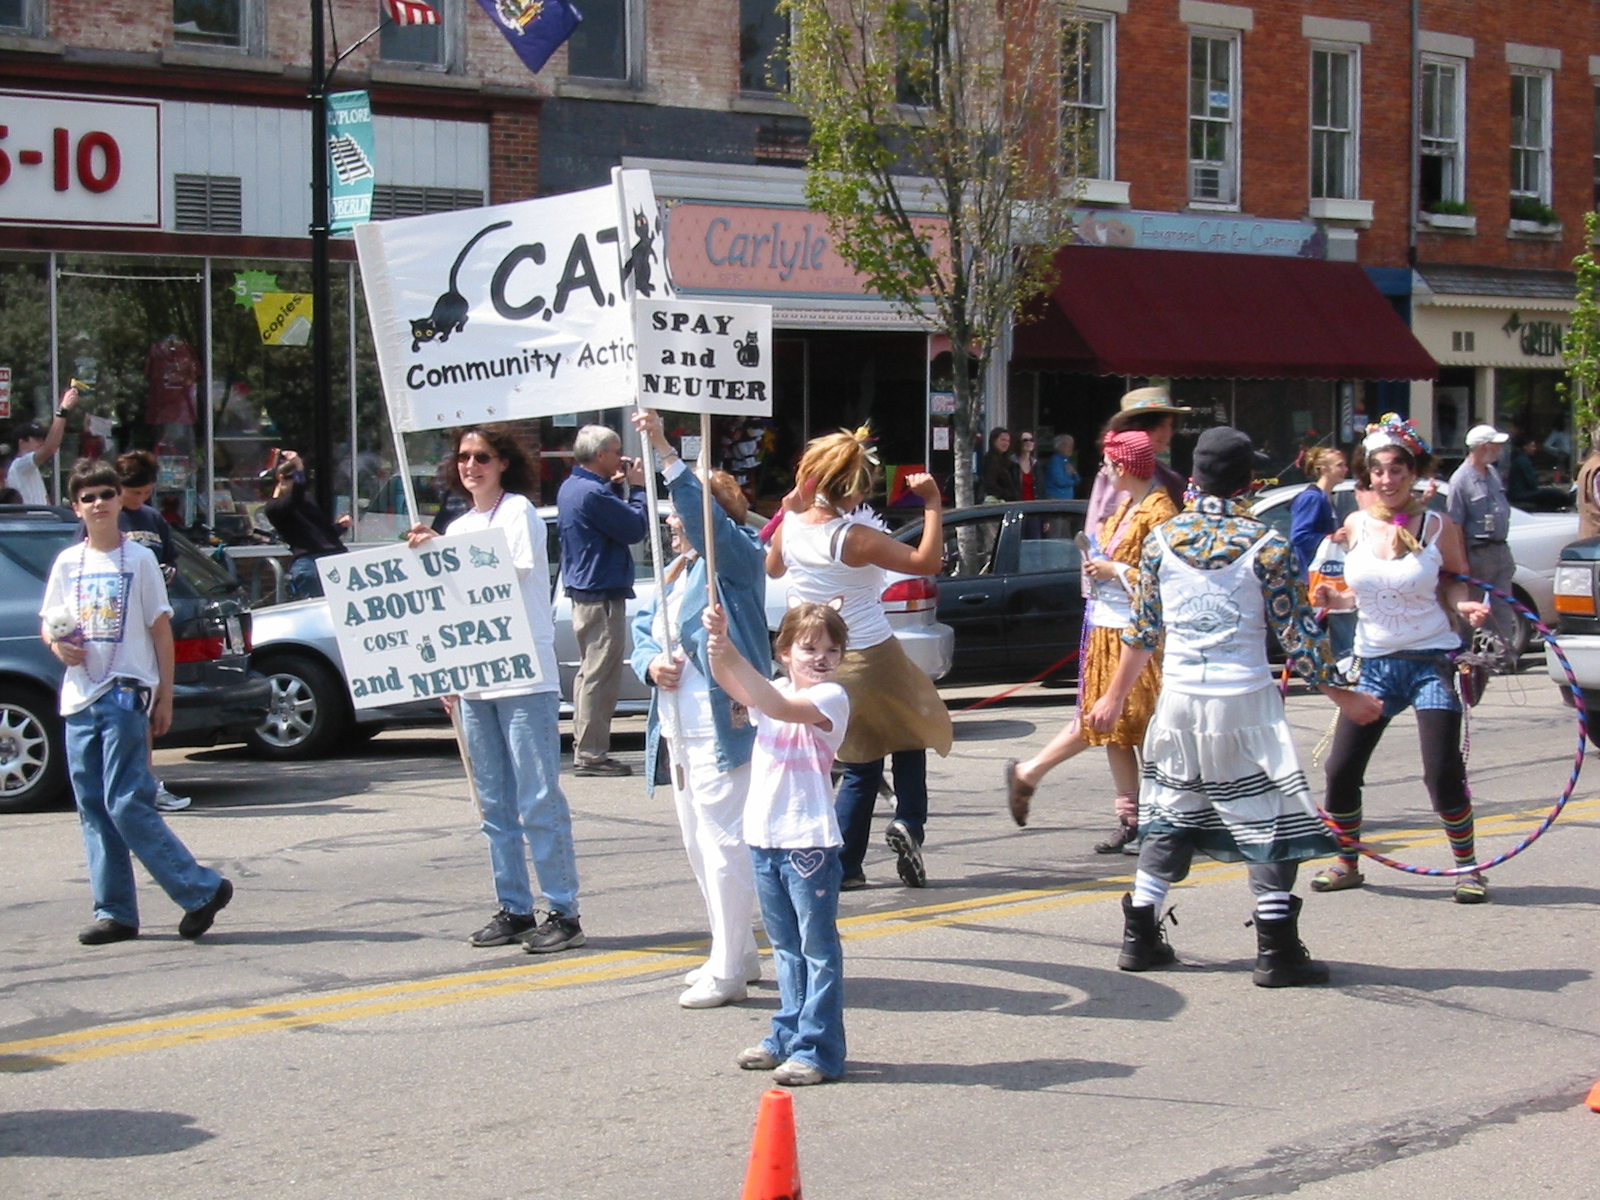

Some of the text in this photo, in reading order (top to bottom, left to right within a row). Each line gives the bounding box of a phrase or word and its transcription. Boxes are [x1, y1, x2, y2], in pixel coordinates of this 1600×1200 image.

[328, 107, 371, 125] EXPLORE
[331, 200, 370, 215] OBERLIN
[705, 217, 828, 281] Carlyle
[262, 294, 304, 340] copies
[652, 311, 734, 335] SPAY
[407, 349, 562, 390] Community
[661, 348, 716, 368] and
[642, 374, 767, 401] NEUTER
[346, 547, 461, 592] ASK US
[344, 583, 512, 627] ABOUT LOW
[363, 616, 512, 652] COST SPAY
[352, 653, 536, 698] and NEUTER
